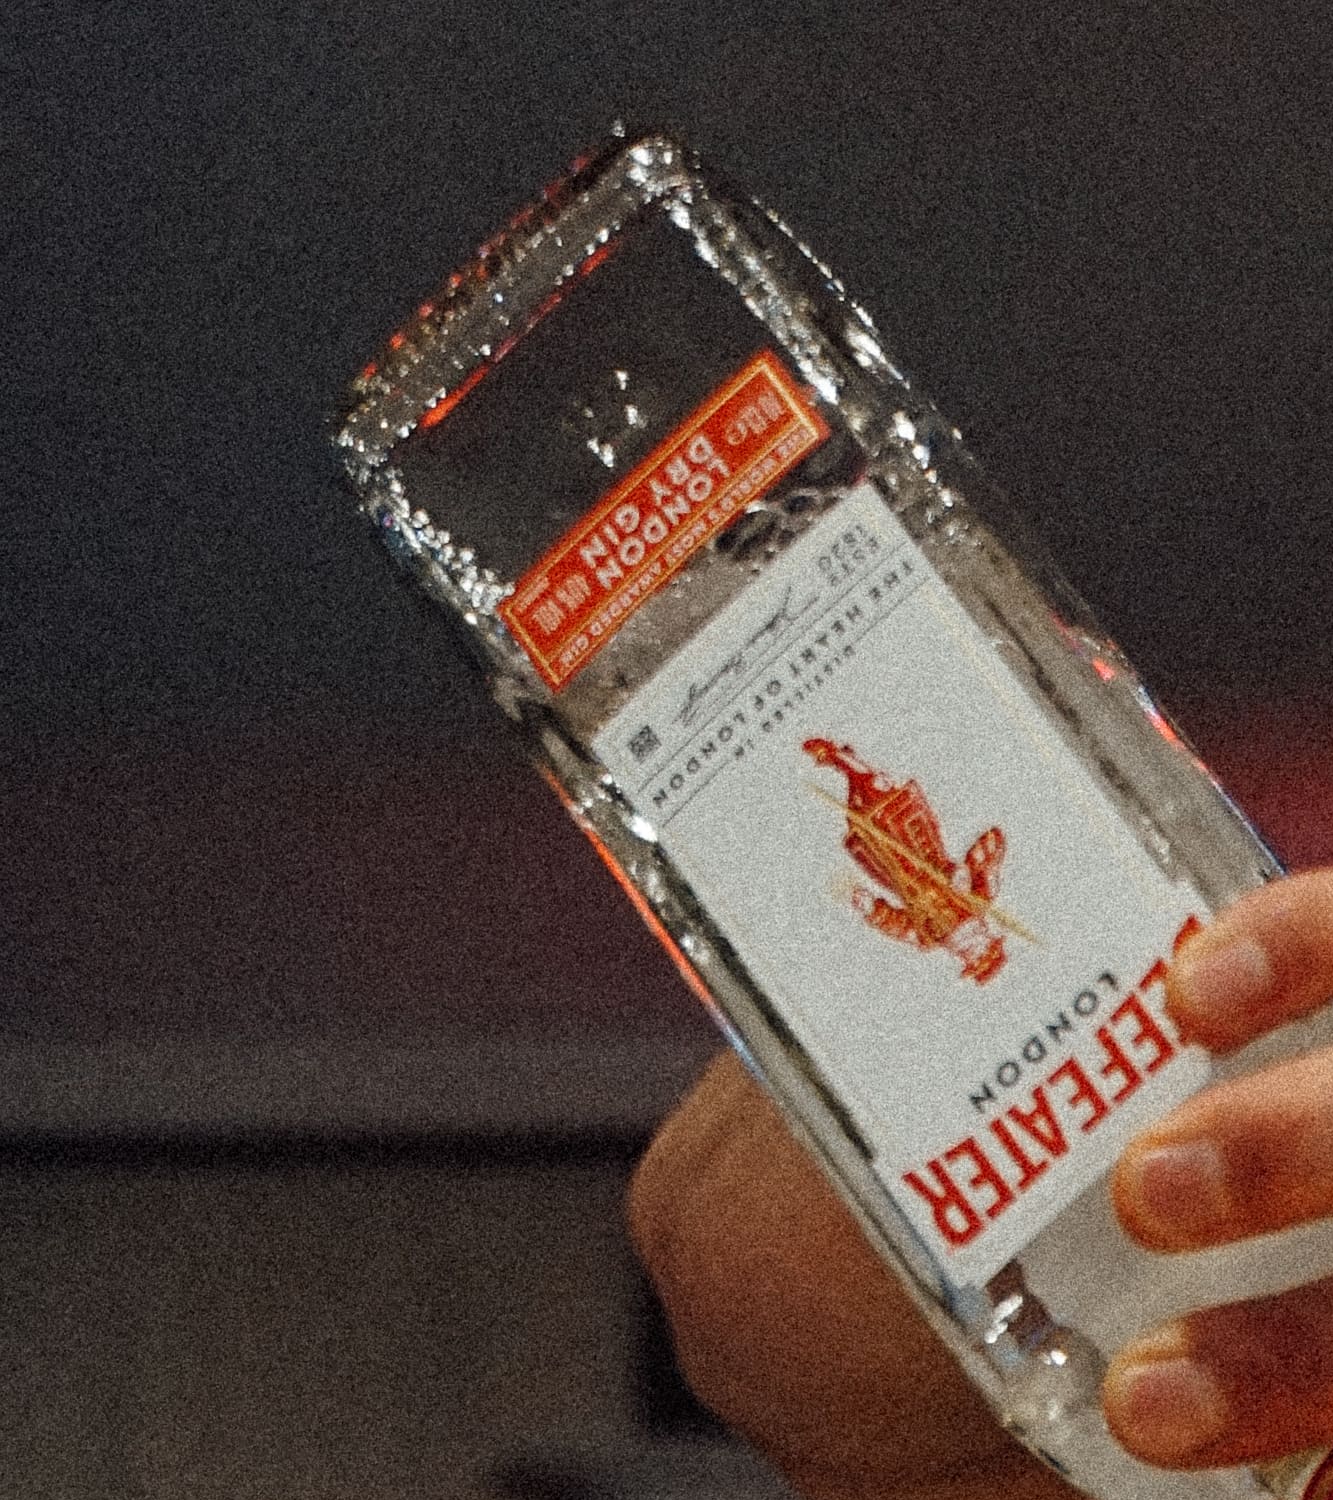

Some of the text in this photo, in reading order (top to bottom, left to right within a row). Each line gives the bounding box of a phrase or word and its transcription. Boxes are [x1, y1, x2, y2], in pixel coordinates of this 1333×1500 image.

[576, 429, 716, 570] DRY GIN
[592, 451, 733, 592] LONDON
[648, 556, 915, 812] THE HEART OF LONDON
[903, 914, 1201, 1252] EFEATER
[968, 970, 1118, 1113] LONDON
